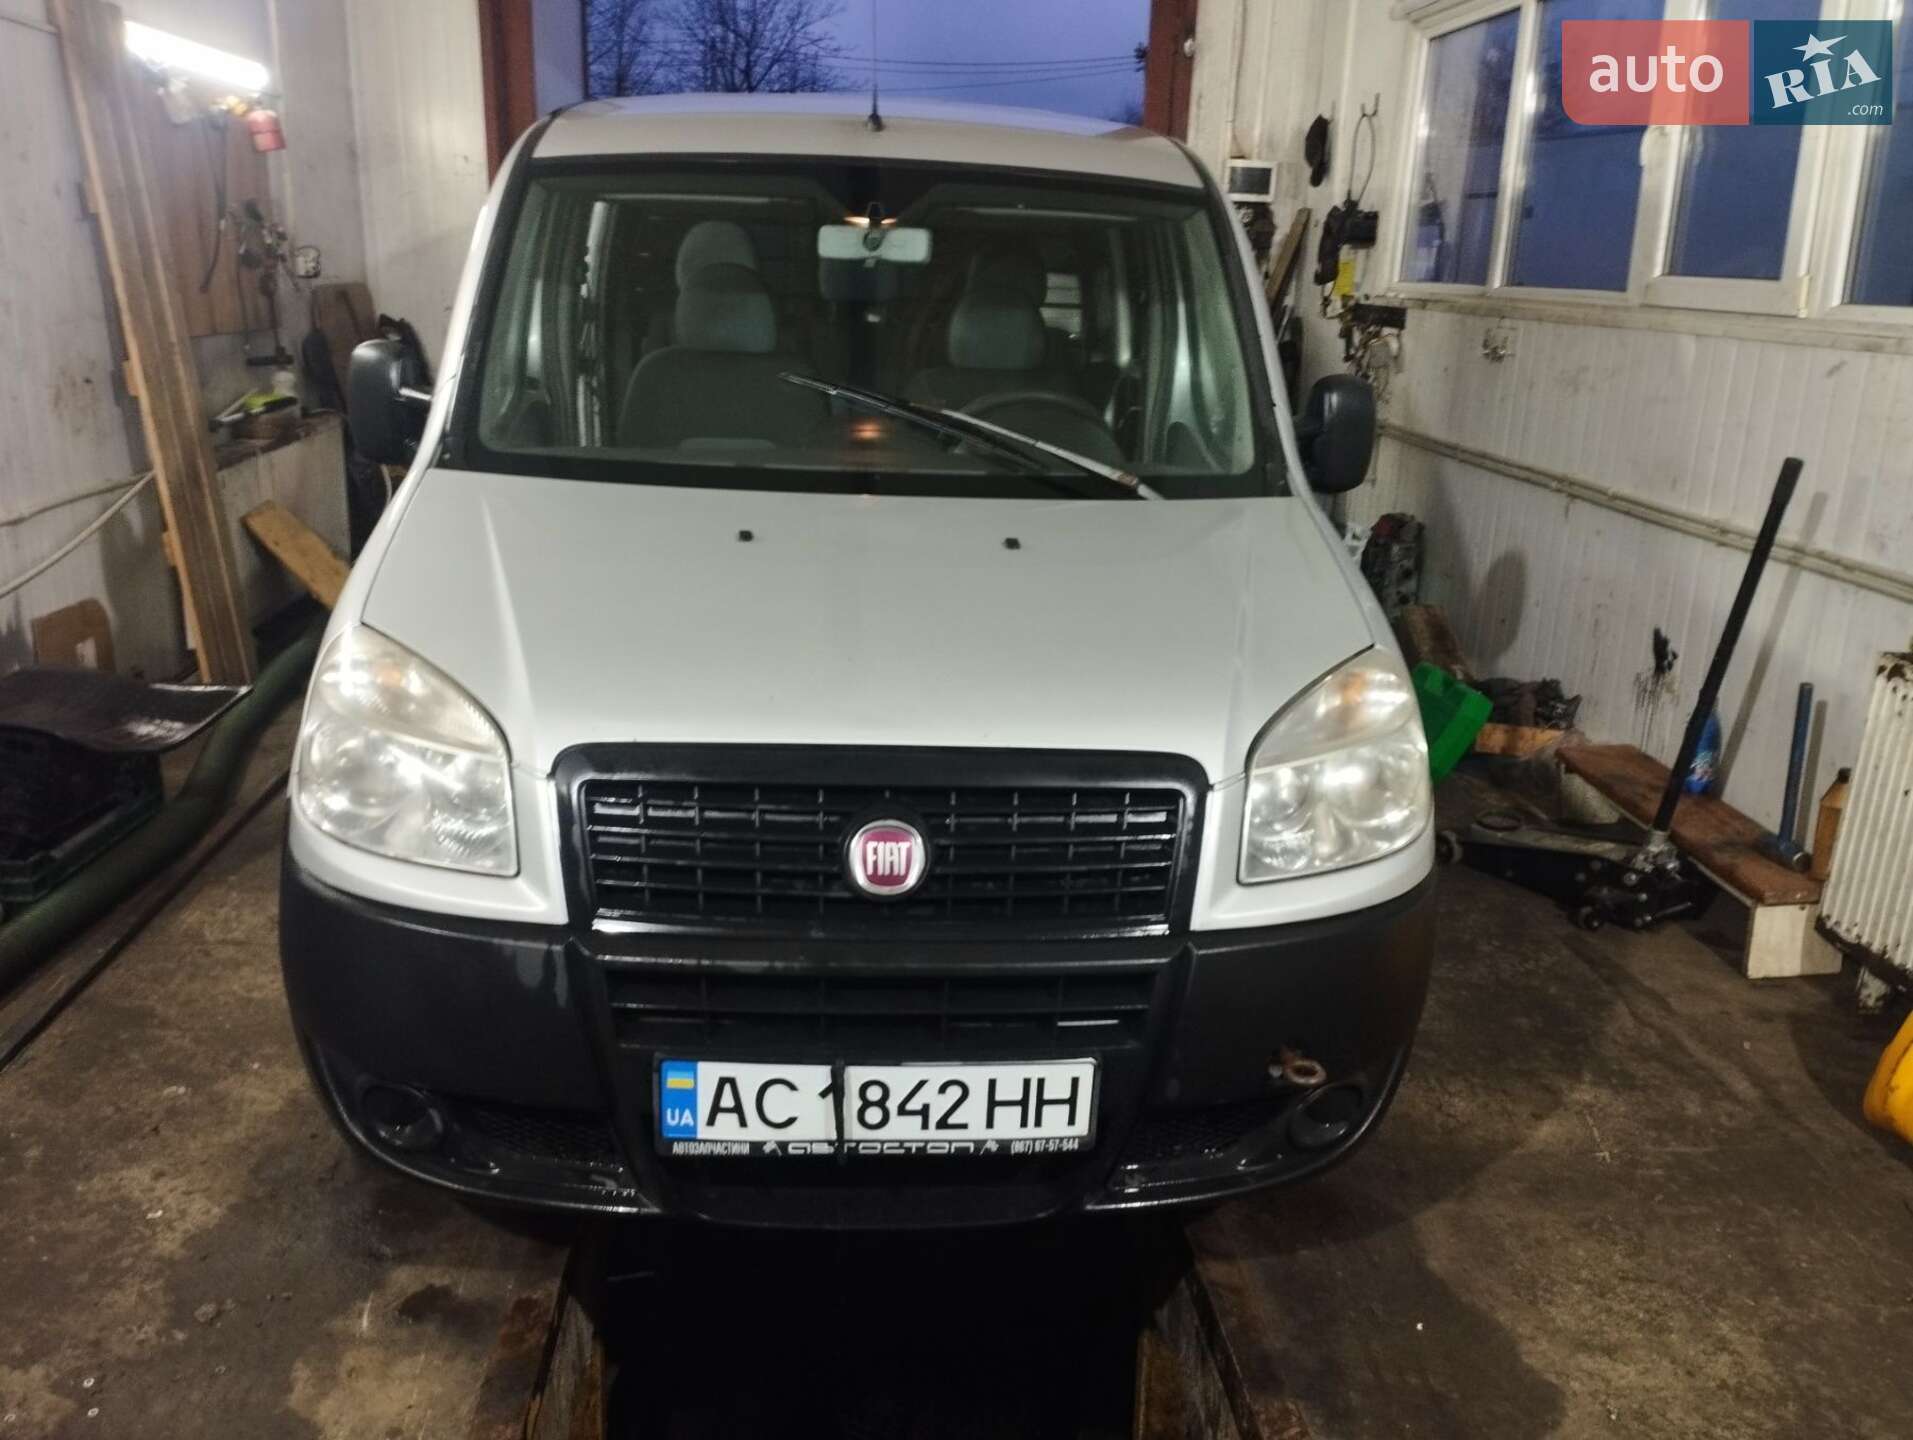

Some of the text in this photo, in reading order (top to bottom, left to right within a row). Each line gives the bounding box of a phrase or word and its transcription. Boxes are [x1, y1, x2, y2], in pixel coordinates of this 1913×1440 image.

[865, 840, 911, 876] FIAT
[666, 1110, 695, 1126] UA
[705, 1076, 1080, 1131] AC 842 HH
